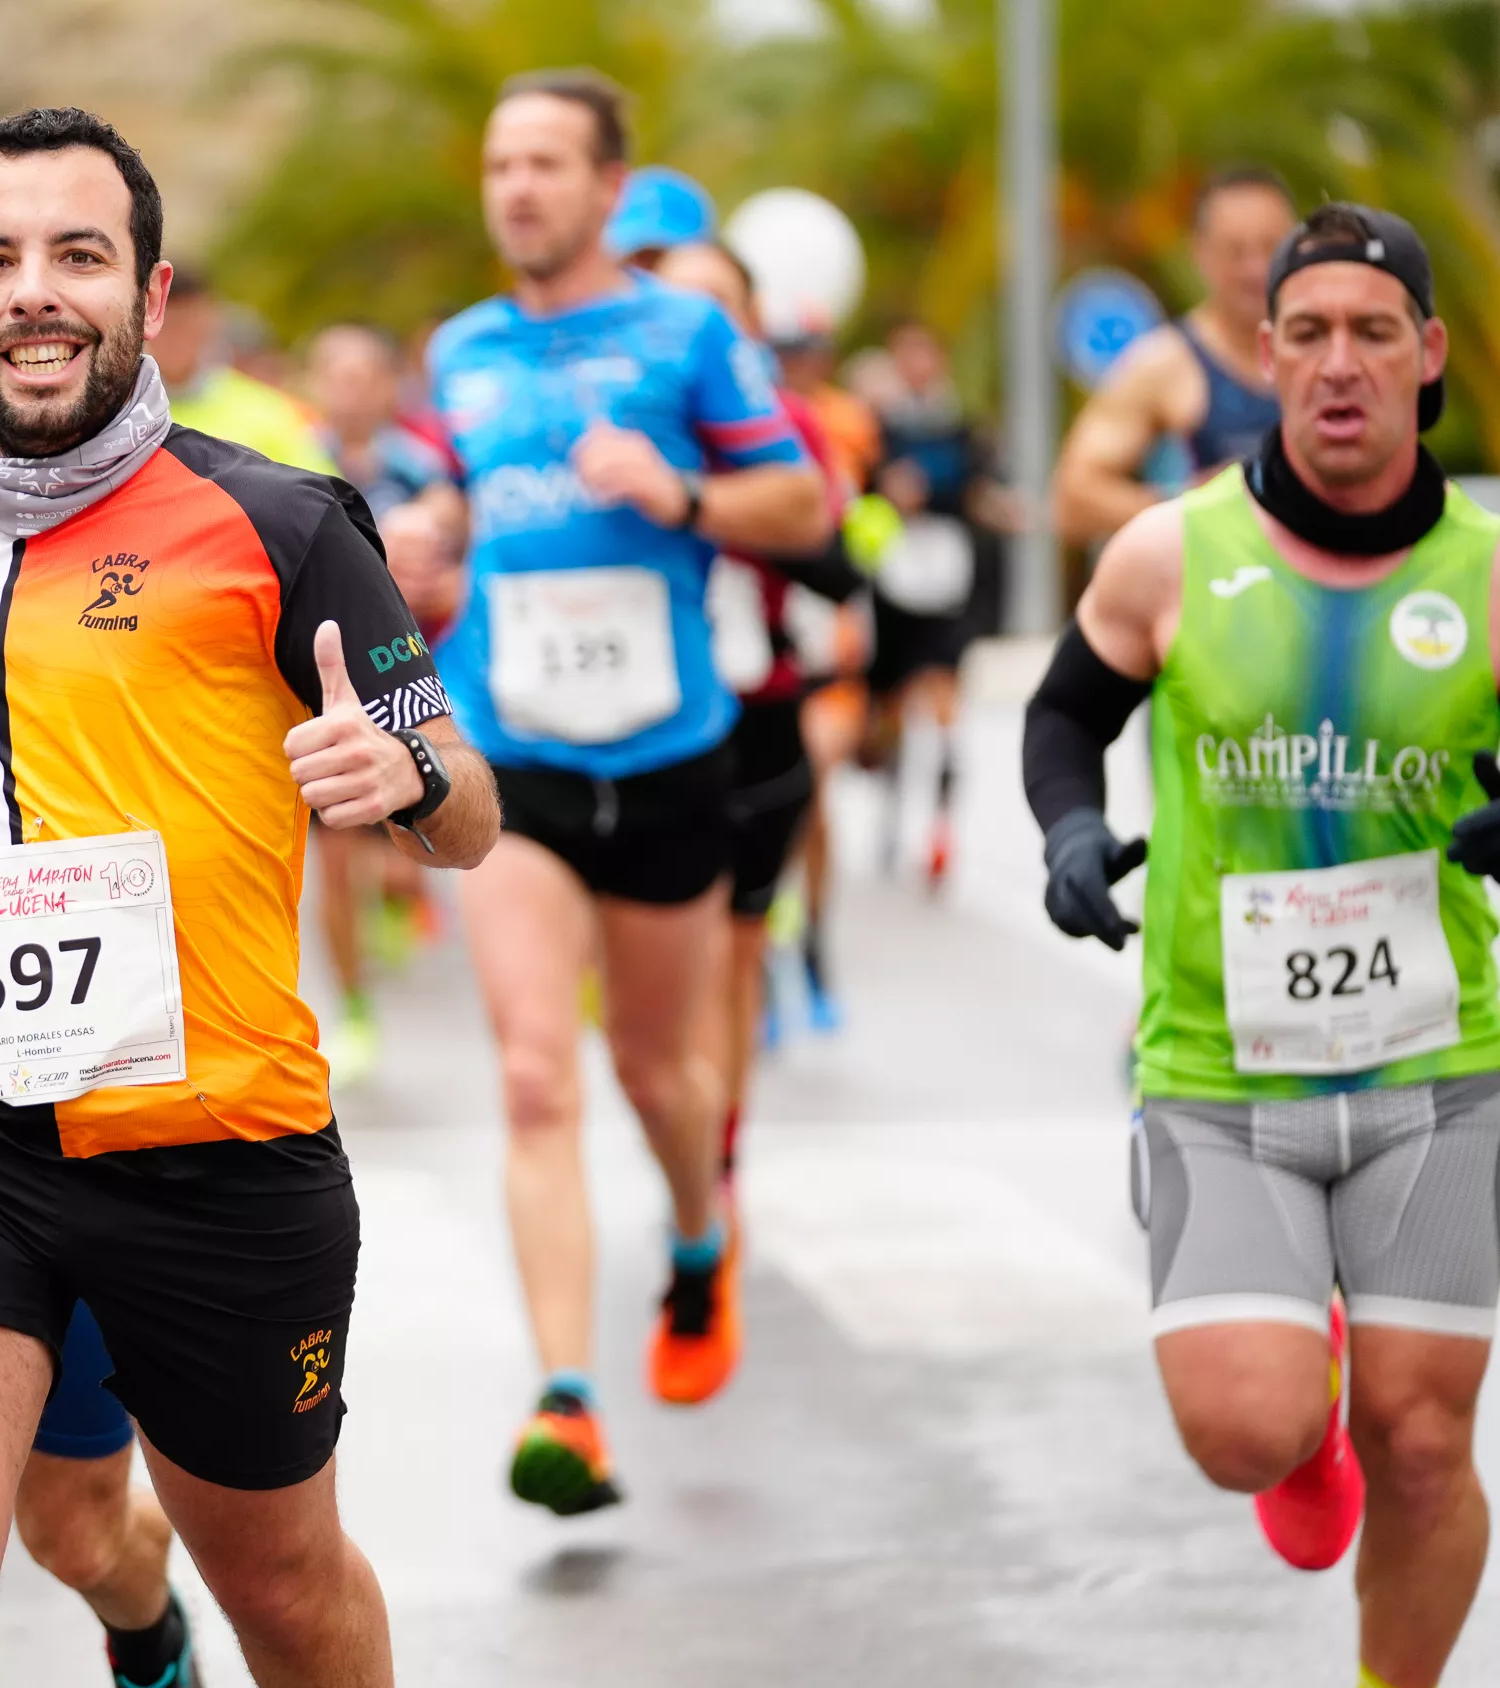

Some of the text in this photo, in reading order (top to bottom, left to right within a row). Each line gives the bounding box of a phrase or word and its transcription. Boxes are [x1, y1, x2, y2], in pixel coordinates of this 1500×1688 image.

[91, 552, 150, 574] CABRA
[78, 613, 138, 632] running
[1196, 713, 1449, 789] CAMPILLOS
[28, 865, 93, 886] MARATÓN
[1285, 937, 1400, 1001] 824
[17, 1030, 62, 1043] MORALES
[64, 1026, 95, 1038] CASAS
[17, 1045, 62, 1058] L-Hombre
[79, 1053, 172, 1076] mediamaratonlucena.com
[290, 1329, 332, 1361] CABRA
